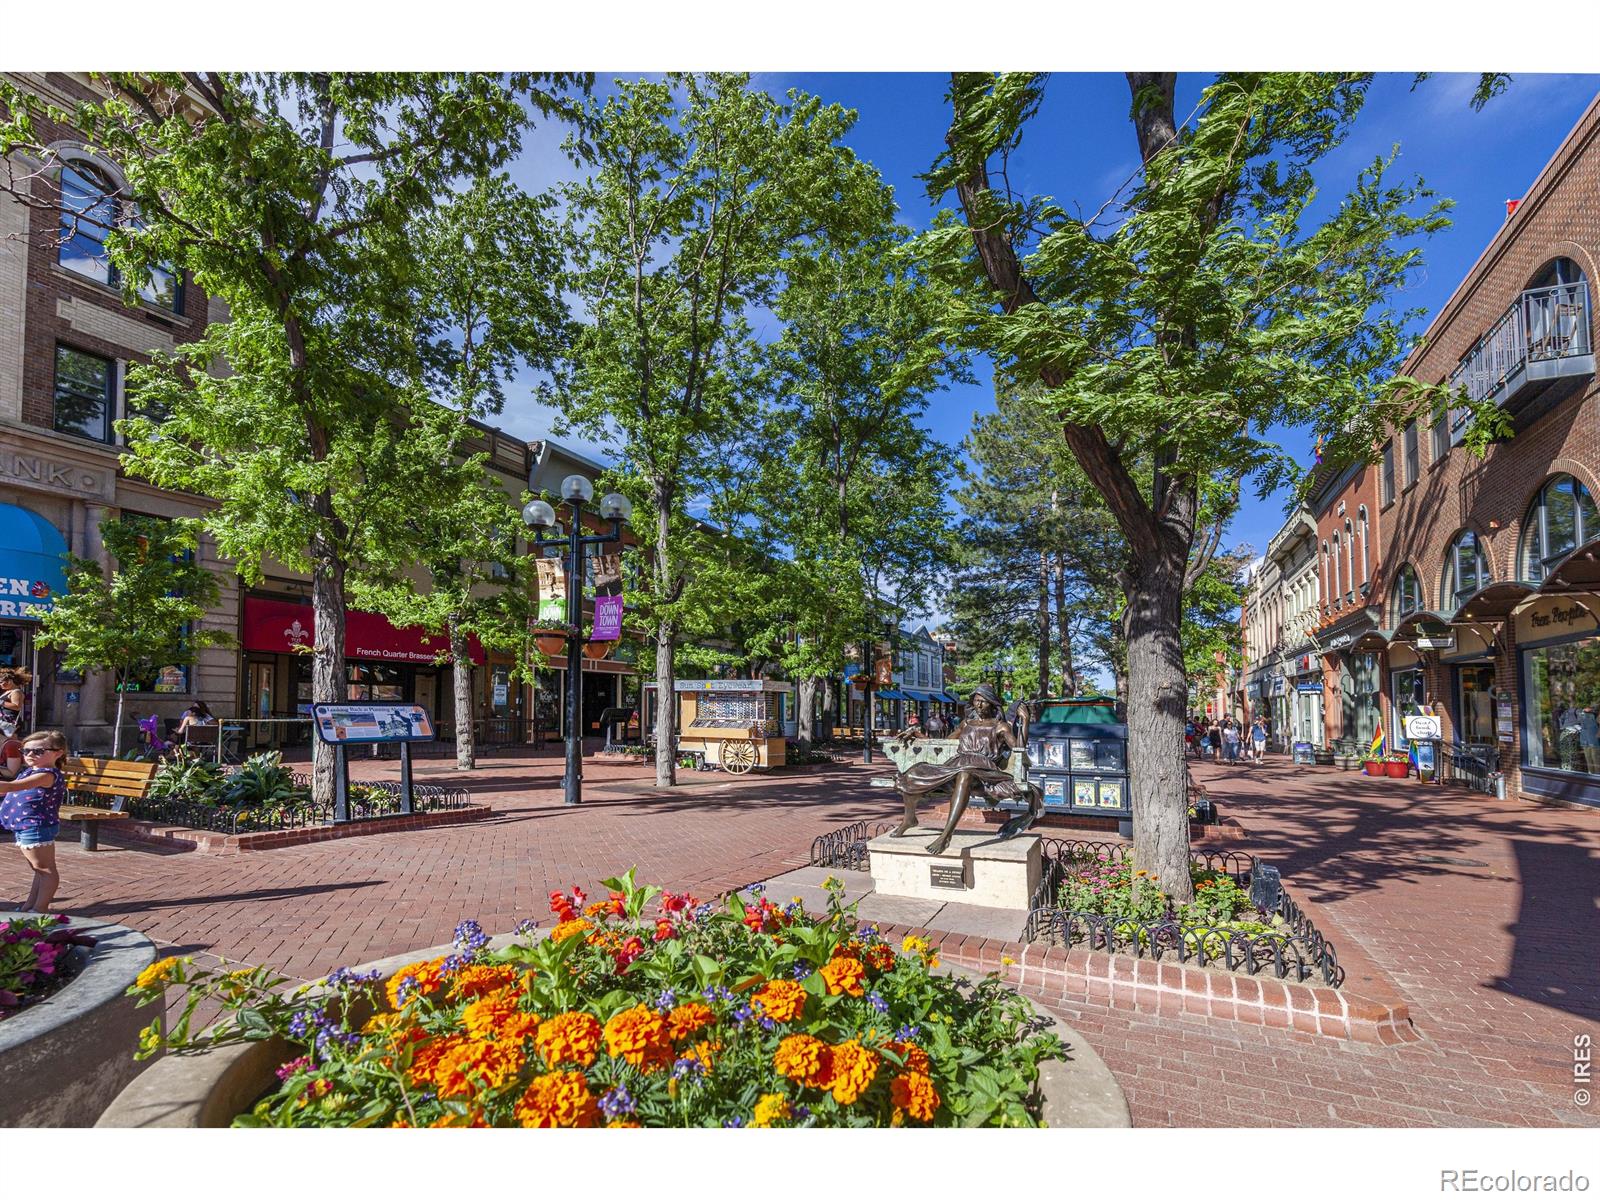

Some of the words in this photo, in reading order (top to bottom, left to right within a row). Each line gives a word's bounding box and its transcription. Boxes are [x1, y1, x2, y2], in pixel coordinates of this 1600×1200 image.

[600, 604, 619, 616] DOWN
[600, 615, 619, 626] TOWN
[356, 647, 381, 656] French
[382, 649, 408, 658] Quarter
